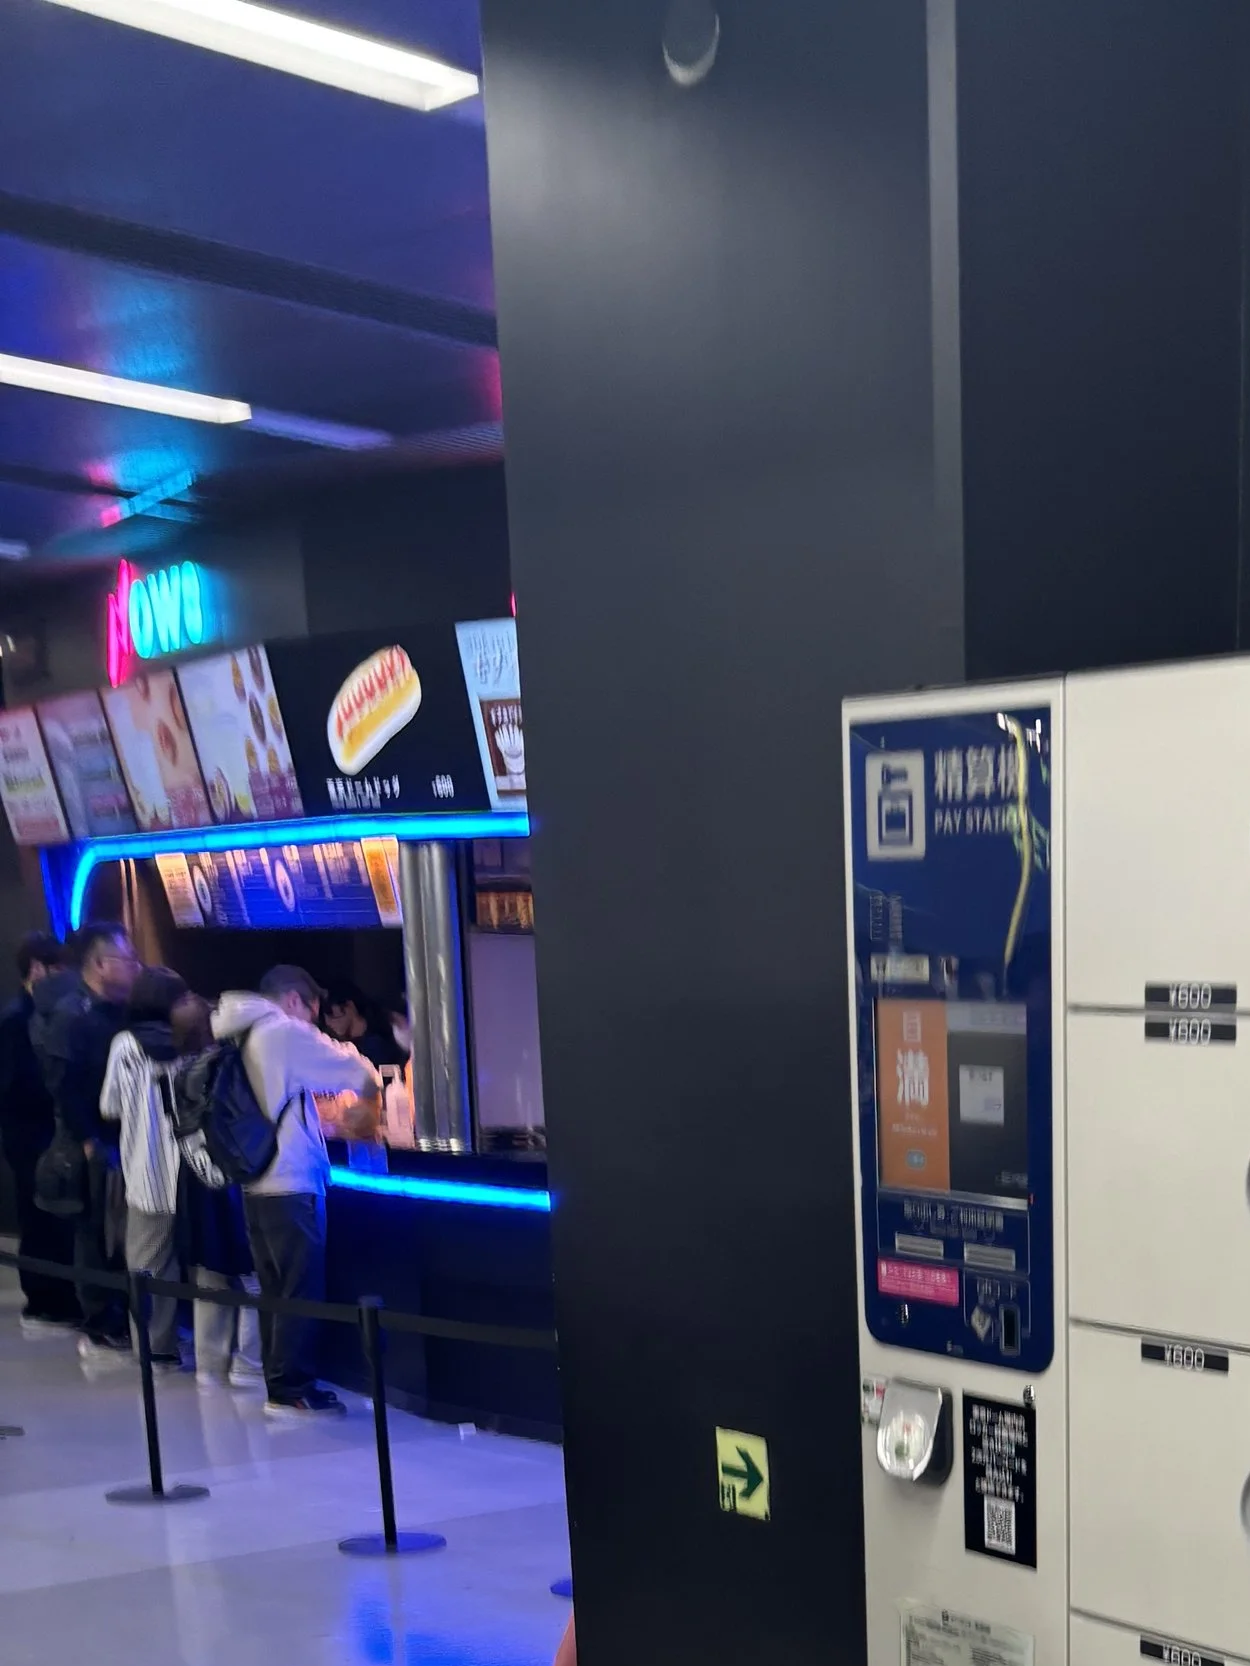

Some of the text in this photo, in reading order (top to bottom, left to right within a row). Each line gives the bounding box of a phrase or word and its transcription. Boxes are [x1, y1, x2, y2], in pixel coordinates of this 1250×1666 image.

[935, 807, 961, 834] PAY
[1169, 982, 1212, 1009] ¥600
[1170, 1019, 1211, 1045] ¥600
[1164, 1344, 1205, 1371] ¥600
